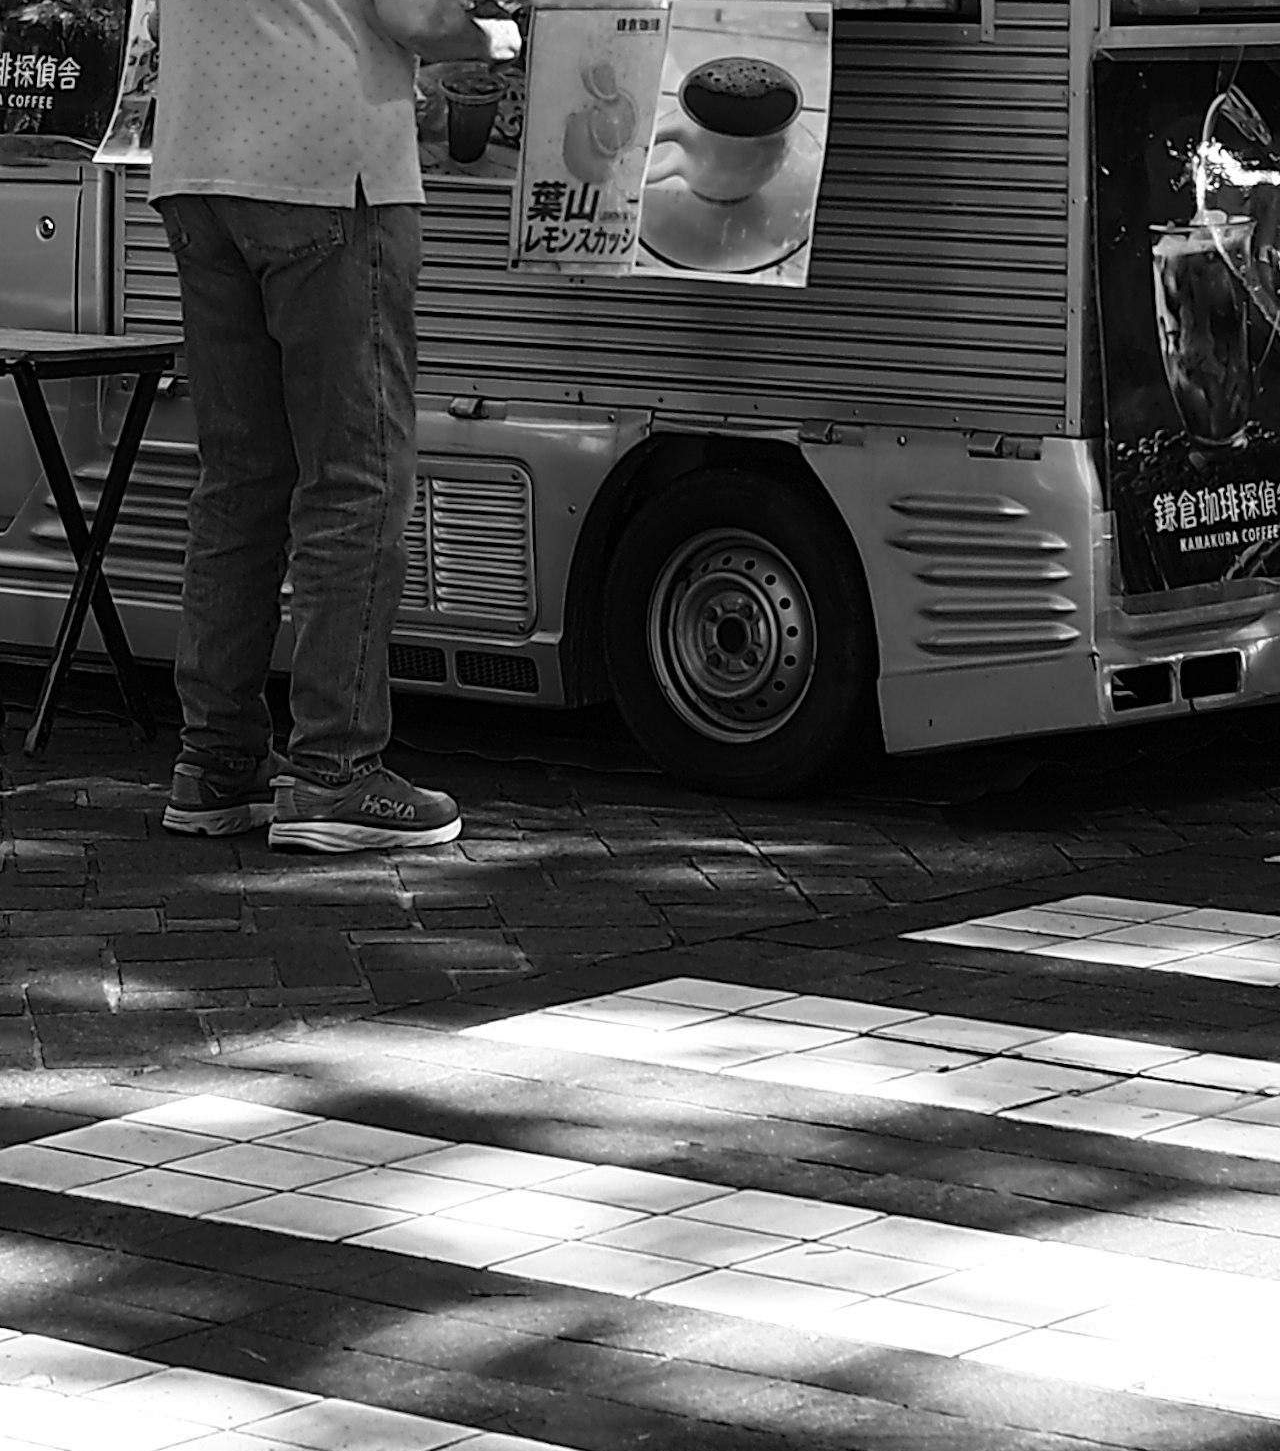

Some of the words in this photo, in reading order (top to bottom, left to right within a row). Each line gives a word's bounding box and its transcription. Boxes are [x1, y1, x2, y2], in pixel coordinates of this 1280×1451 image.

[7, 94, 54, 110] COFFEE
[527, 181, 600, 223] 葉山
[1179, 530, 1239, 553] KAMAKURA
[1241, 524, 1279, 544] COFFEE
[360, 794, 416, 820] HOKA
